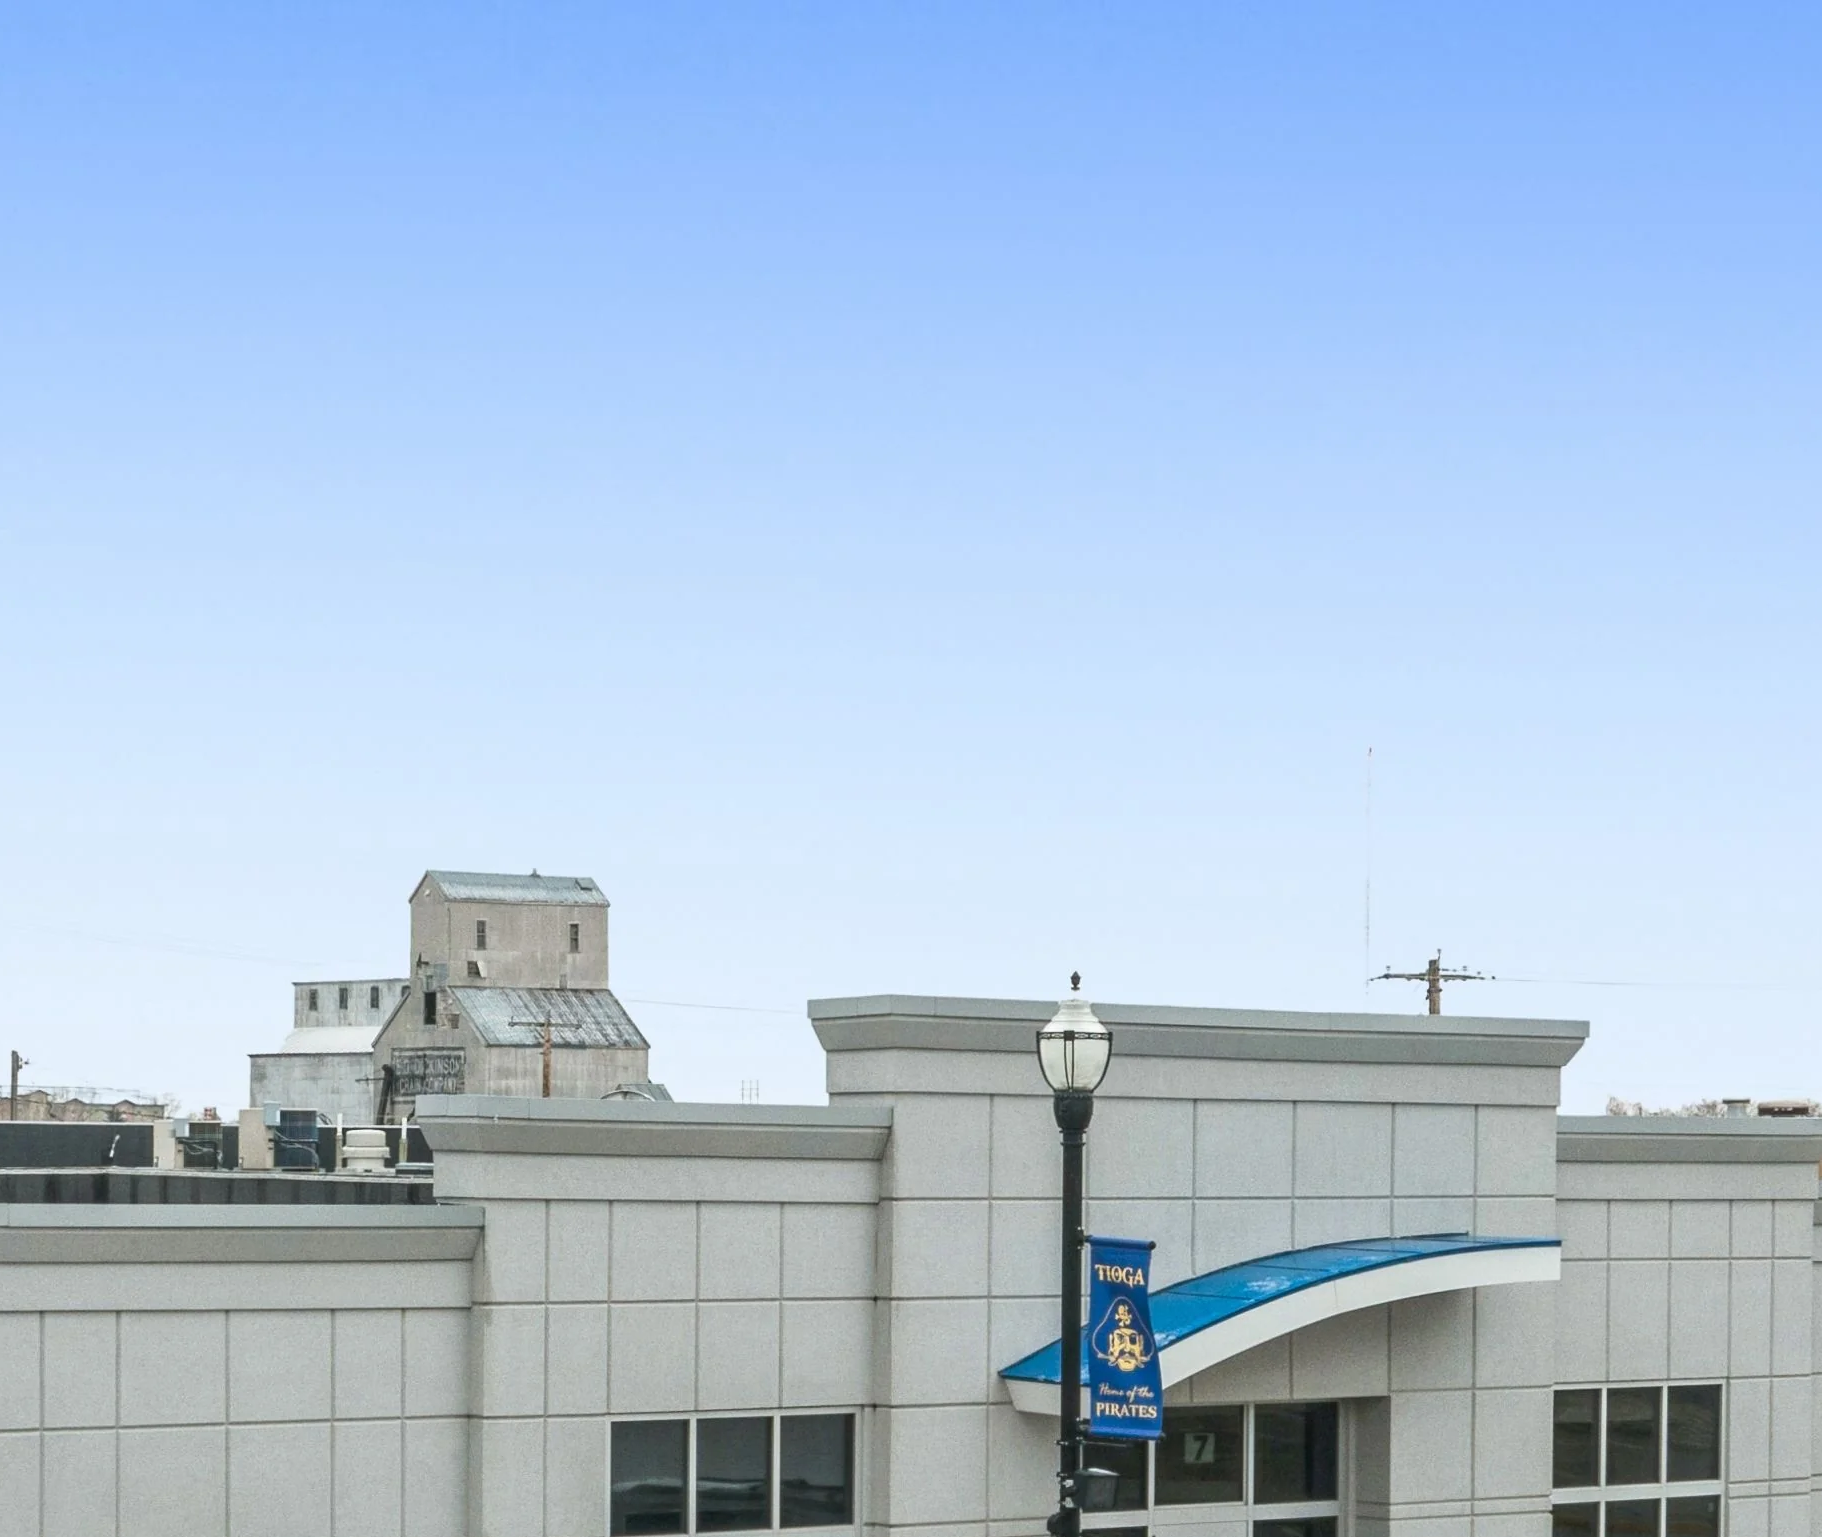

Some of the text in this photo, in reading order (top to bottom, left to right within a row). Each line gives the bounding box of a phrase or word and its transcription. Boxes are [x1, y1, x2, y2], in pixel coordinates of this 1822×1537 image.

[1094, 1264, 1145, 1288] TIOGA
[1099, 1382, 1155, 1403] Home of the
[1096, 1402, 1158, 1419] PIRATES
[1192, 1434, 1209, 1461] 7
